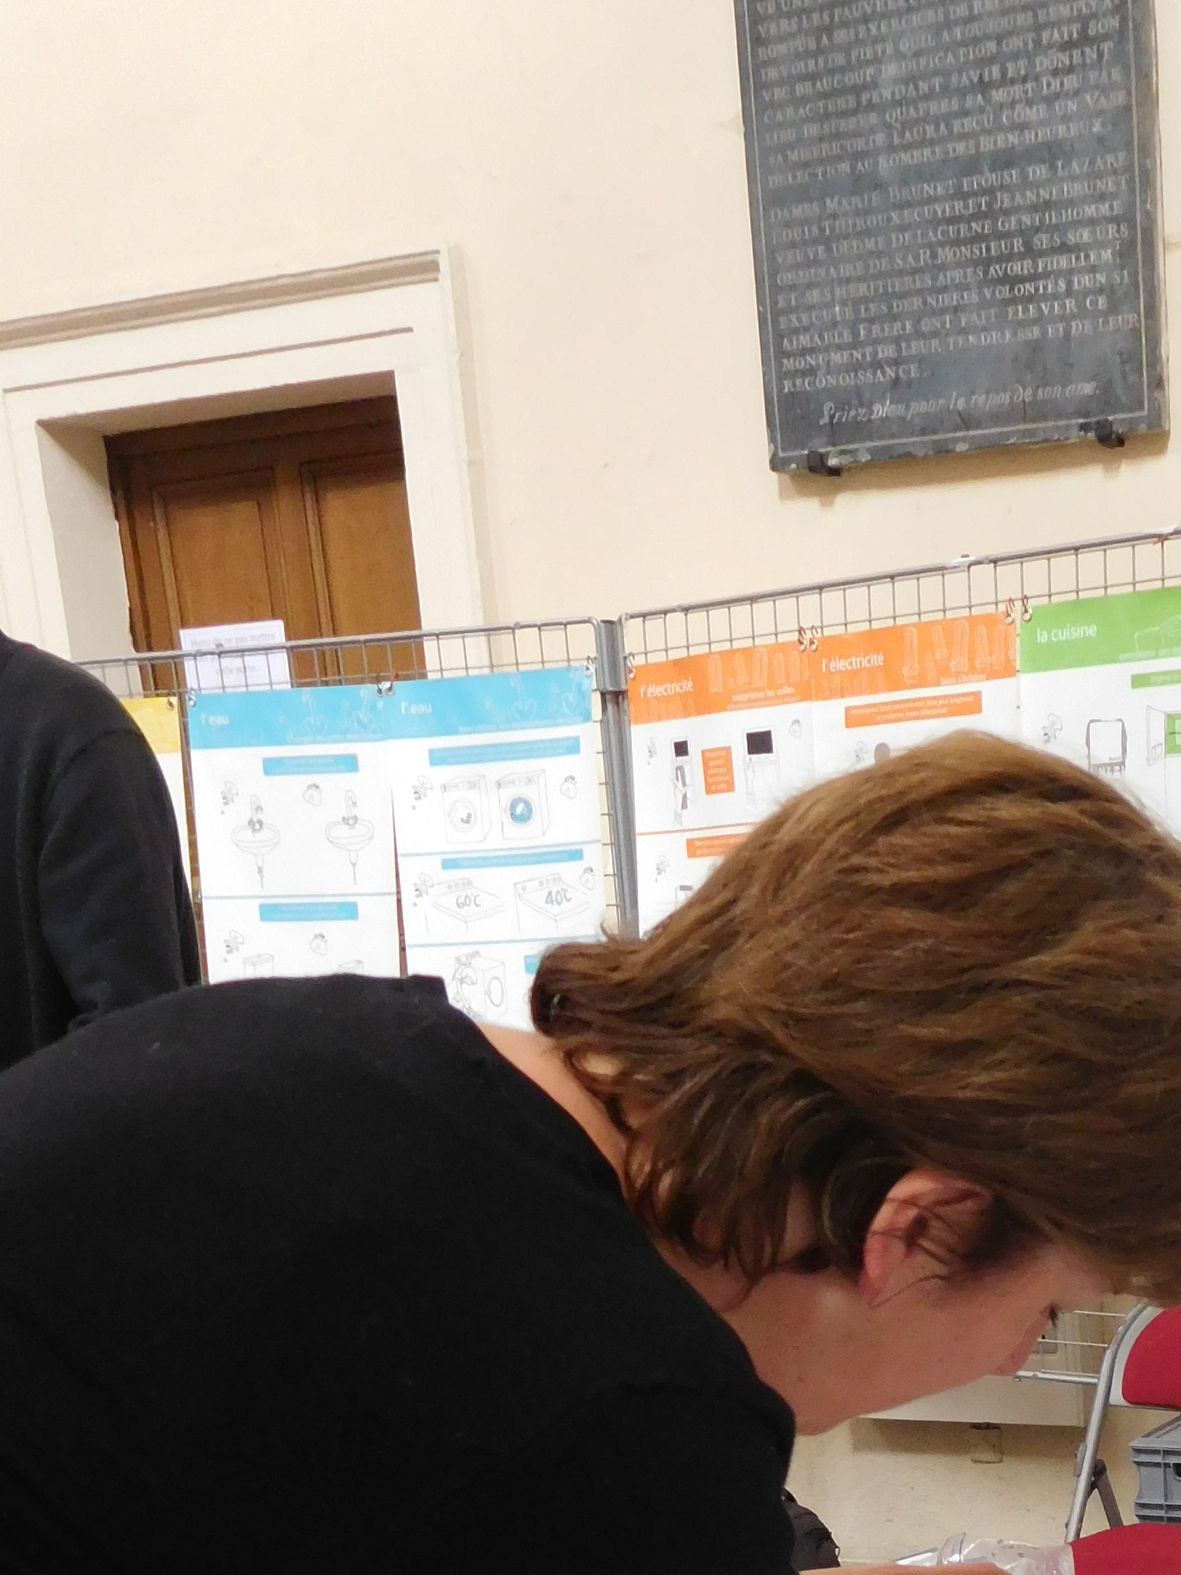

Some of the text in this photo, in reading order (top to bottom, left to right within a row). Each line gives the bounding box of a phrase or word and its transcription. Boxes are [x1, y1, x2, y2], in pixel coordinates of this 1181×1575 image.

[1098, 311, 1141, 334] LEUR
[1036, 623, 1098, 644] la cuisine
